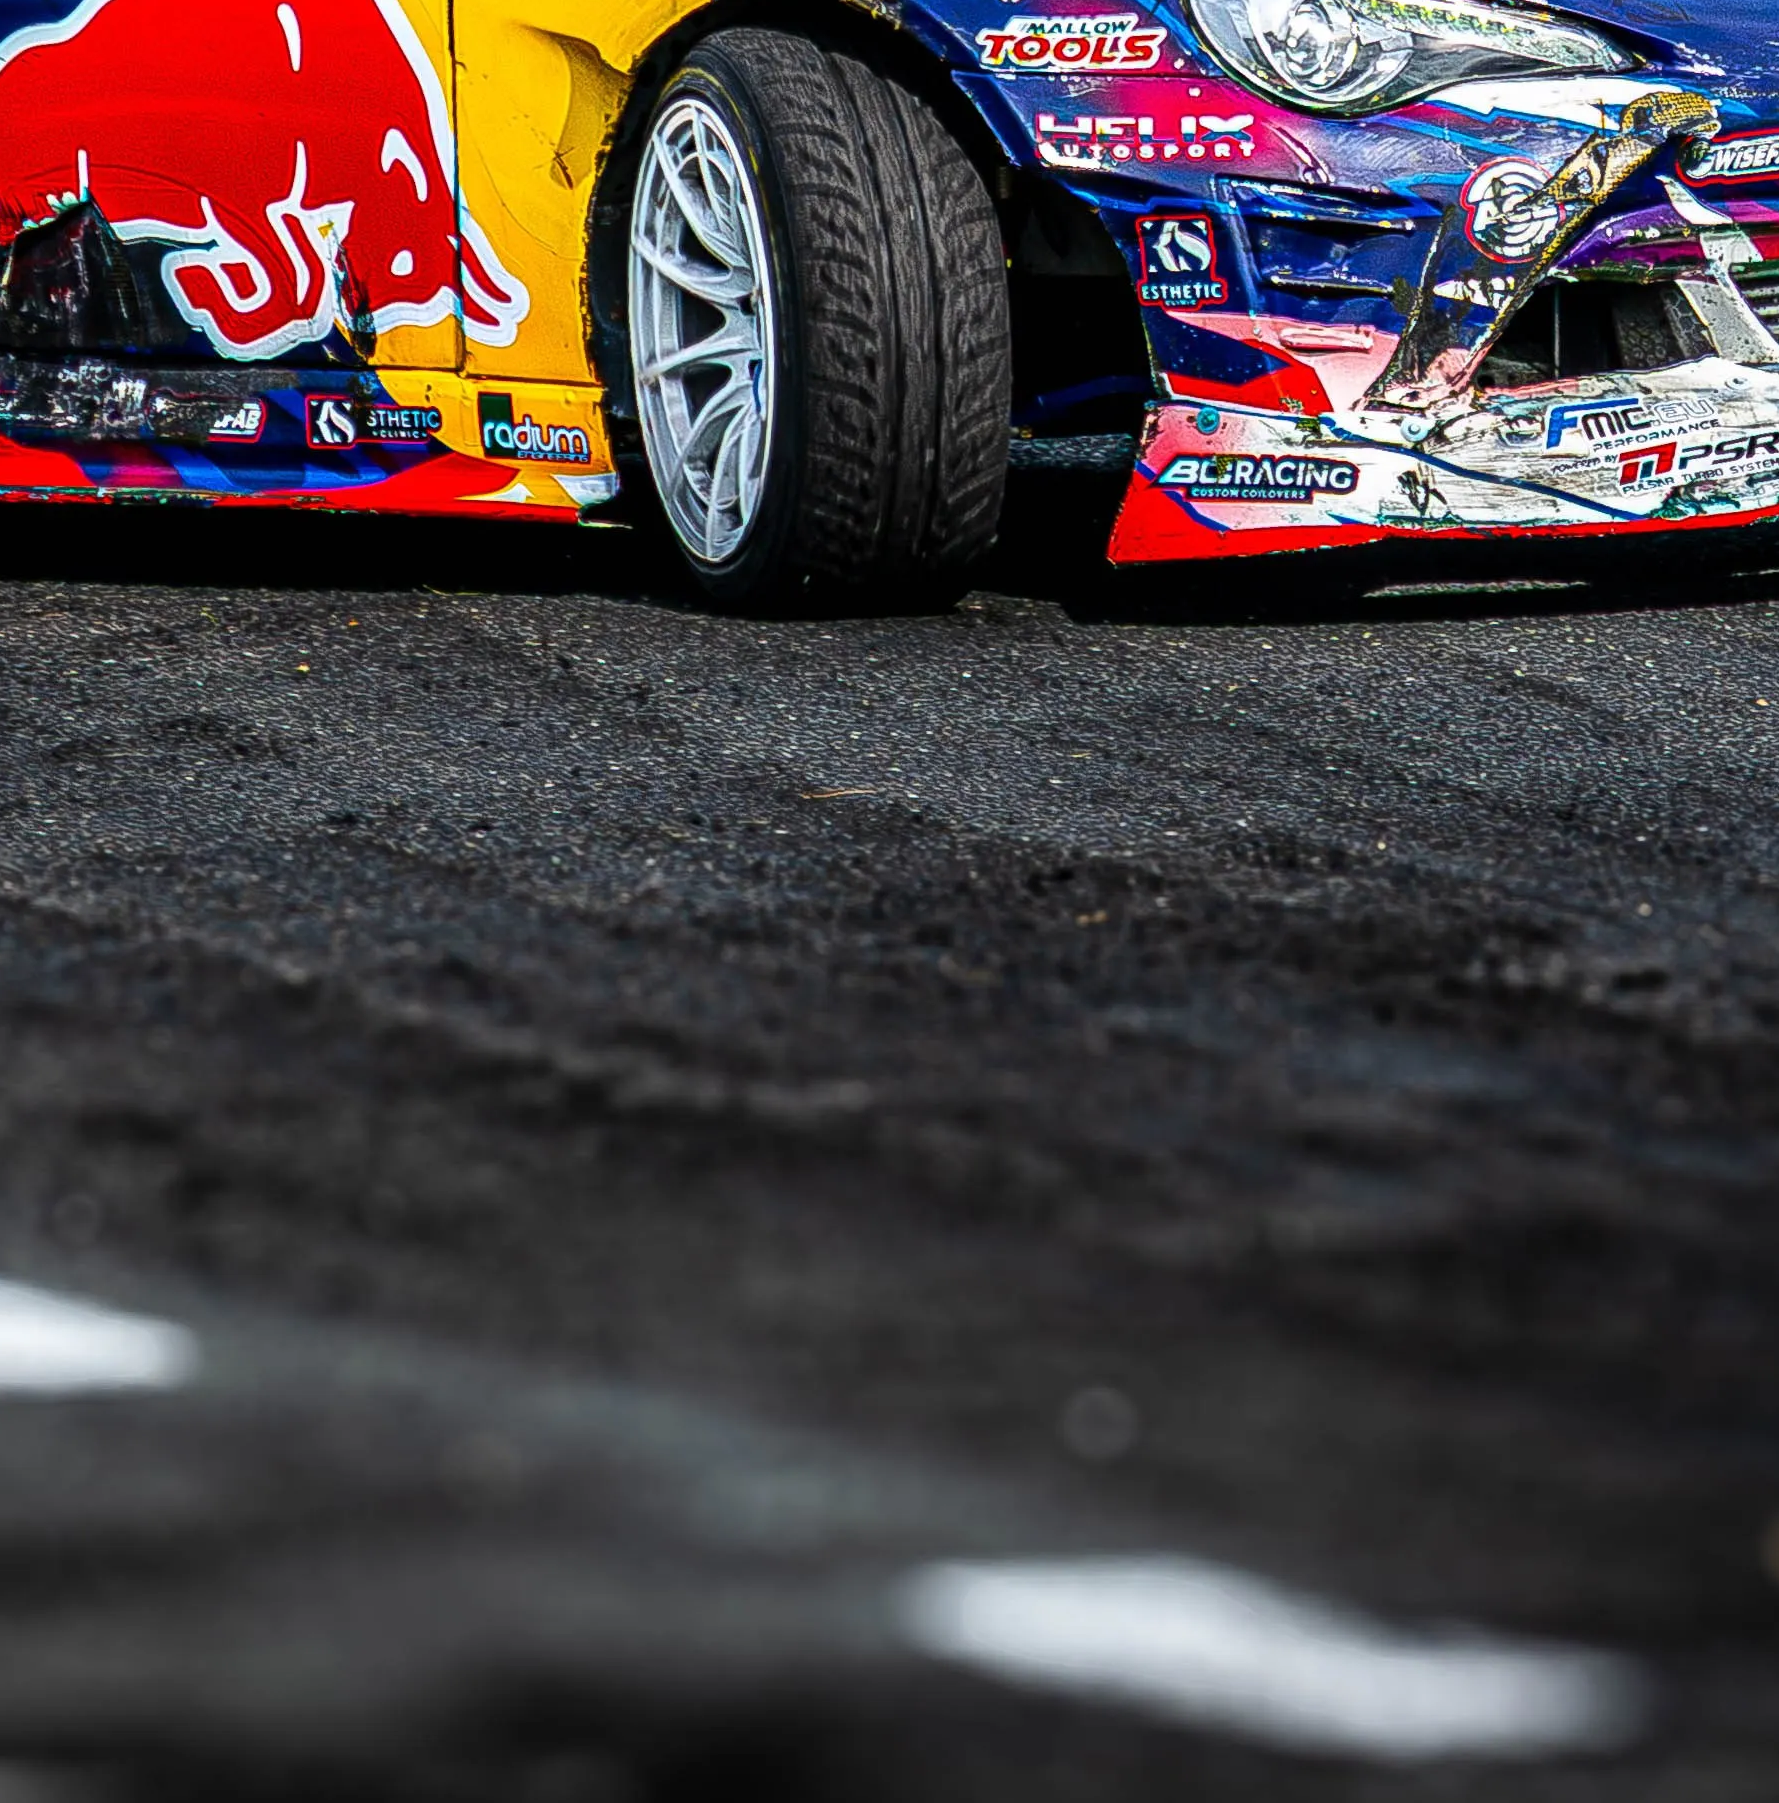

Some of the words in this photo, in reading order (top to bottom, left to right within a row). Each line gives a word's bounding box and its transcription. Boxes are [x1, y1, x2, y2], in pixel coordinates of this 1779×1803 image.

[1026, 20, 1132, 34] MALLOW
[983, 34, 1160, 64] TOOLS
[1037, 114, 1256, 143] HELIX
[1142, 282, 1223, 300] ESTHETIC
[364, 407, 440, 429] STHETIC
[482, 417, 589, 454] radium
[1593, 418, 1721, 452] PERFORMANCE
[1191, 487, 1239, 499] CUSTOM
[1240, 488, 1307, 500] COILOVERS
[1622, 476, 1675, 495] PULSAR
[1682, 465, 1724, 484] TURBO
